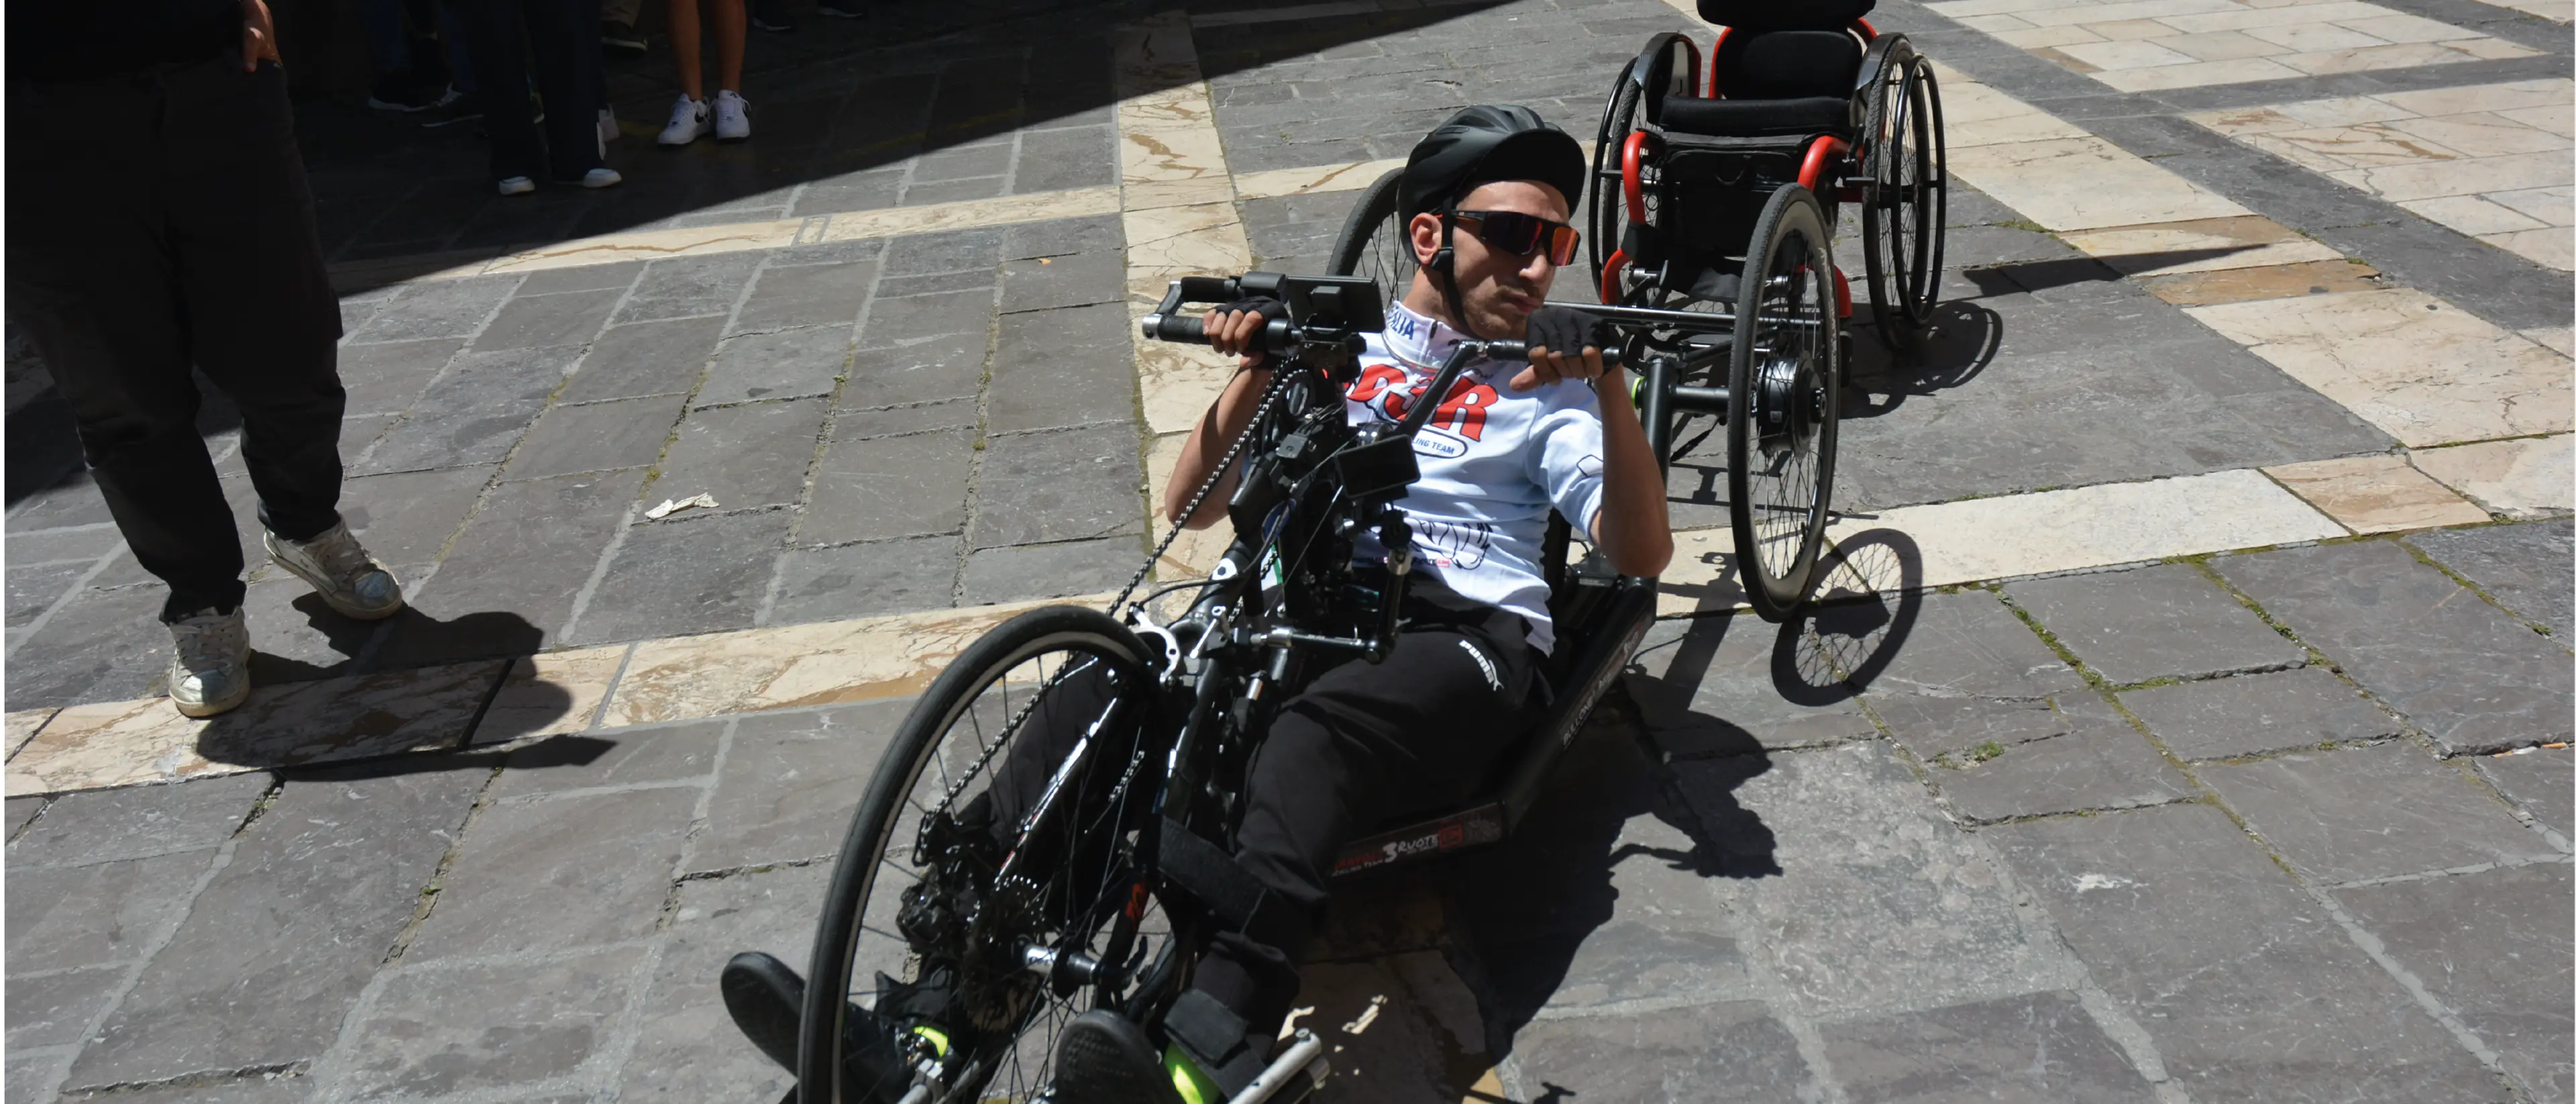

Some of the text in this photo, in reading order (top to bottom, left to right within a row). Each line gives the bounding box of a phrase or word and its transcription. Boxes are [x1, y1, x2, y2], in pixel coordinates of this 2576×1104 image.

[1388, 306, 1415, 341] ALIA
[1432, 442, 1455, 455] TEAM
[1458, 639, 1495, 684] PUMA
